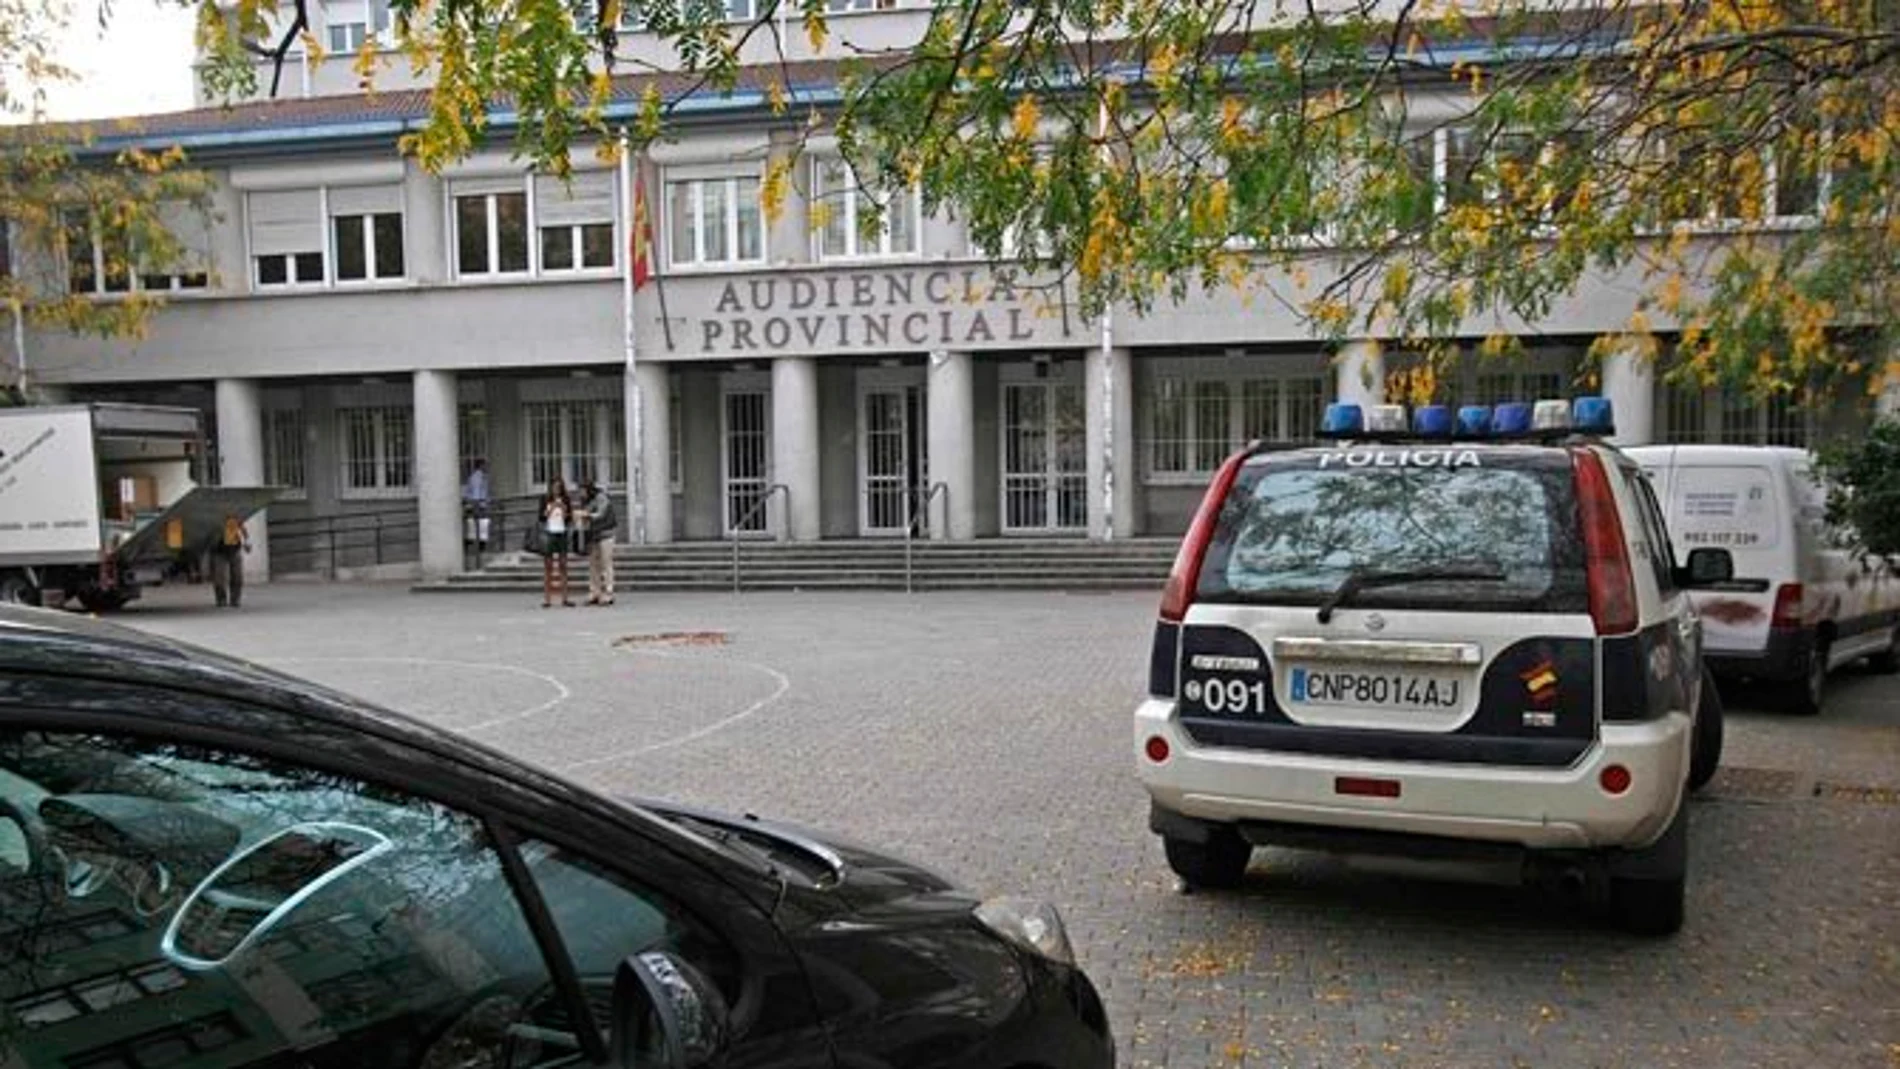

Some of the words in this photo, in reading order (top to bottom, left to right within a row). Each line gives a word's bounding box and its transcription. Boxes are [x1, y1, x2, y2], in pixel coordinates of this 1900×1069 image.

[718, 270, 1016, 312] AUDIENCIA
[702, 309, 1033, 350] PROVINCIAL
[1205, 679, 1265, 713] 091
[1307, 674, 1458, 706] CNP8014AJ
